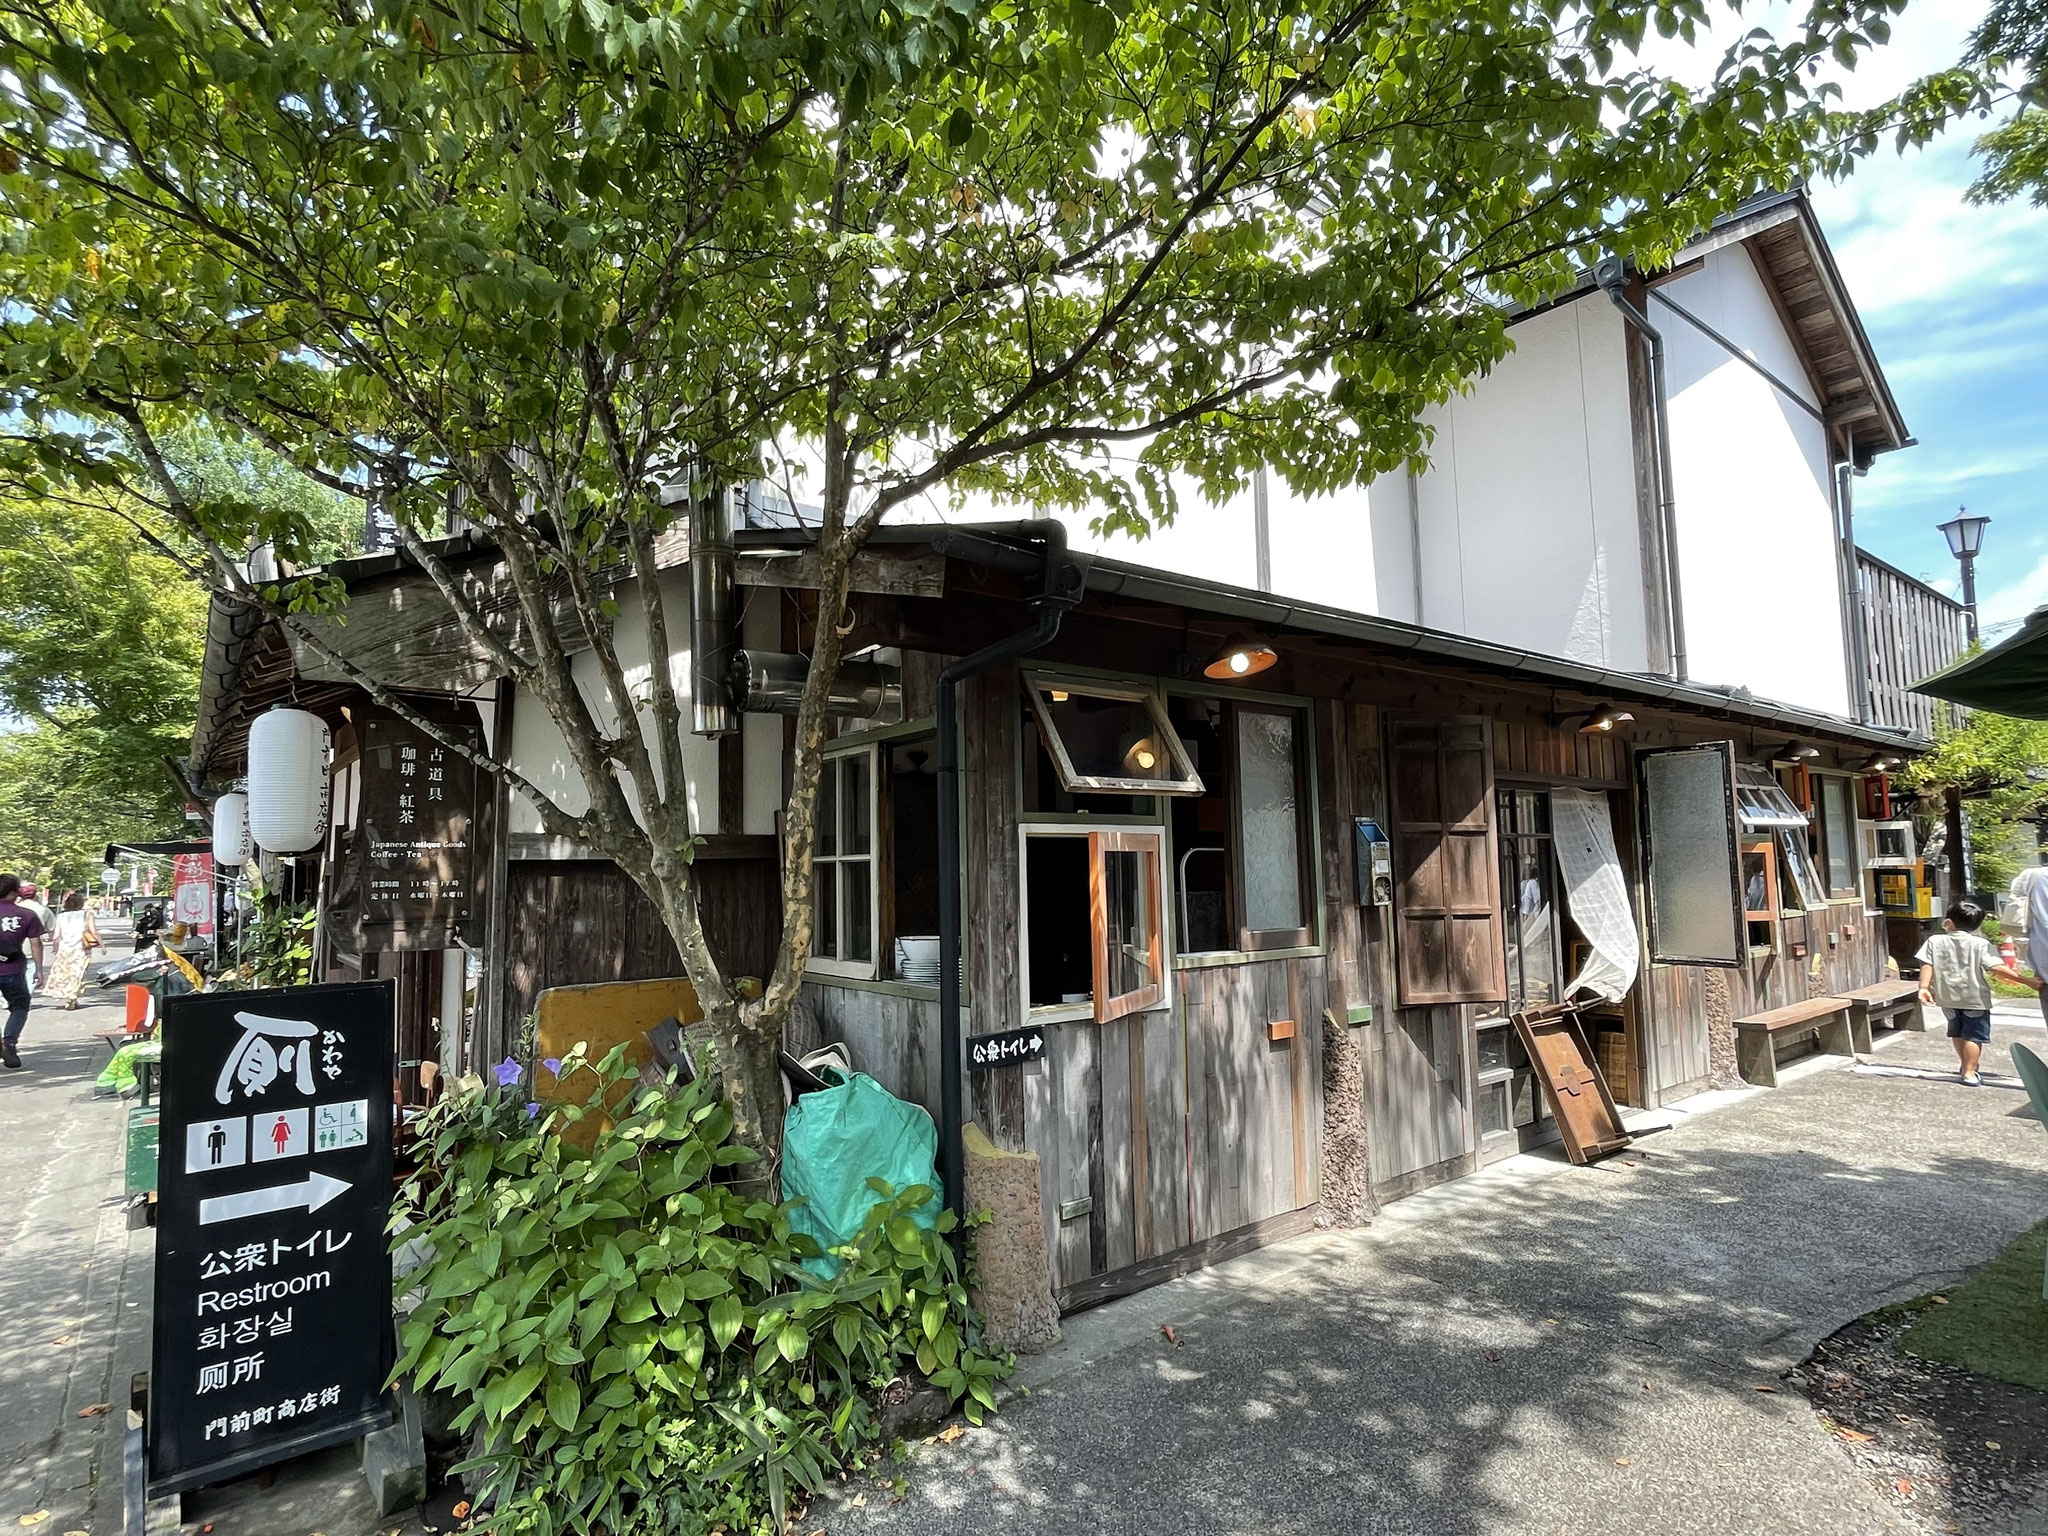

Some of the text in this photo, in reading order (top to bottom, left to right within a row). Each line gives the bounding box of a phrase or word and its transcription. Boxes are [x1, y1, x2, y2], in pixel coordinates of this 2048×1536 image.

[398, 747, 416, 824] 珈琲・紅茶
[428, 748, 444, 801] 古道具
[370, 840, 467, 850] Japanese Antique Goods
[371, 880, 400, 888] 営業時間
[214, 1011, 320, 1105] 厠
[321, 1029, 346, 1080] かわや
[973, 1037, 1029, 1064] 公衆トイレ
[199, 1229, 353, 1280] 公衆トイレ
[197, 1270, 331, 1316] Restroom
[196, 1306, 293, 1351] 화장실
[195, 1351, 266, 1396] 厕所
[204, 1384, 342, 1441] 門前町商店街
